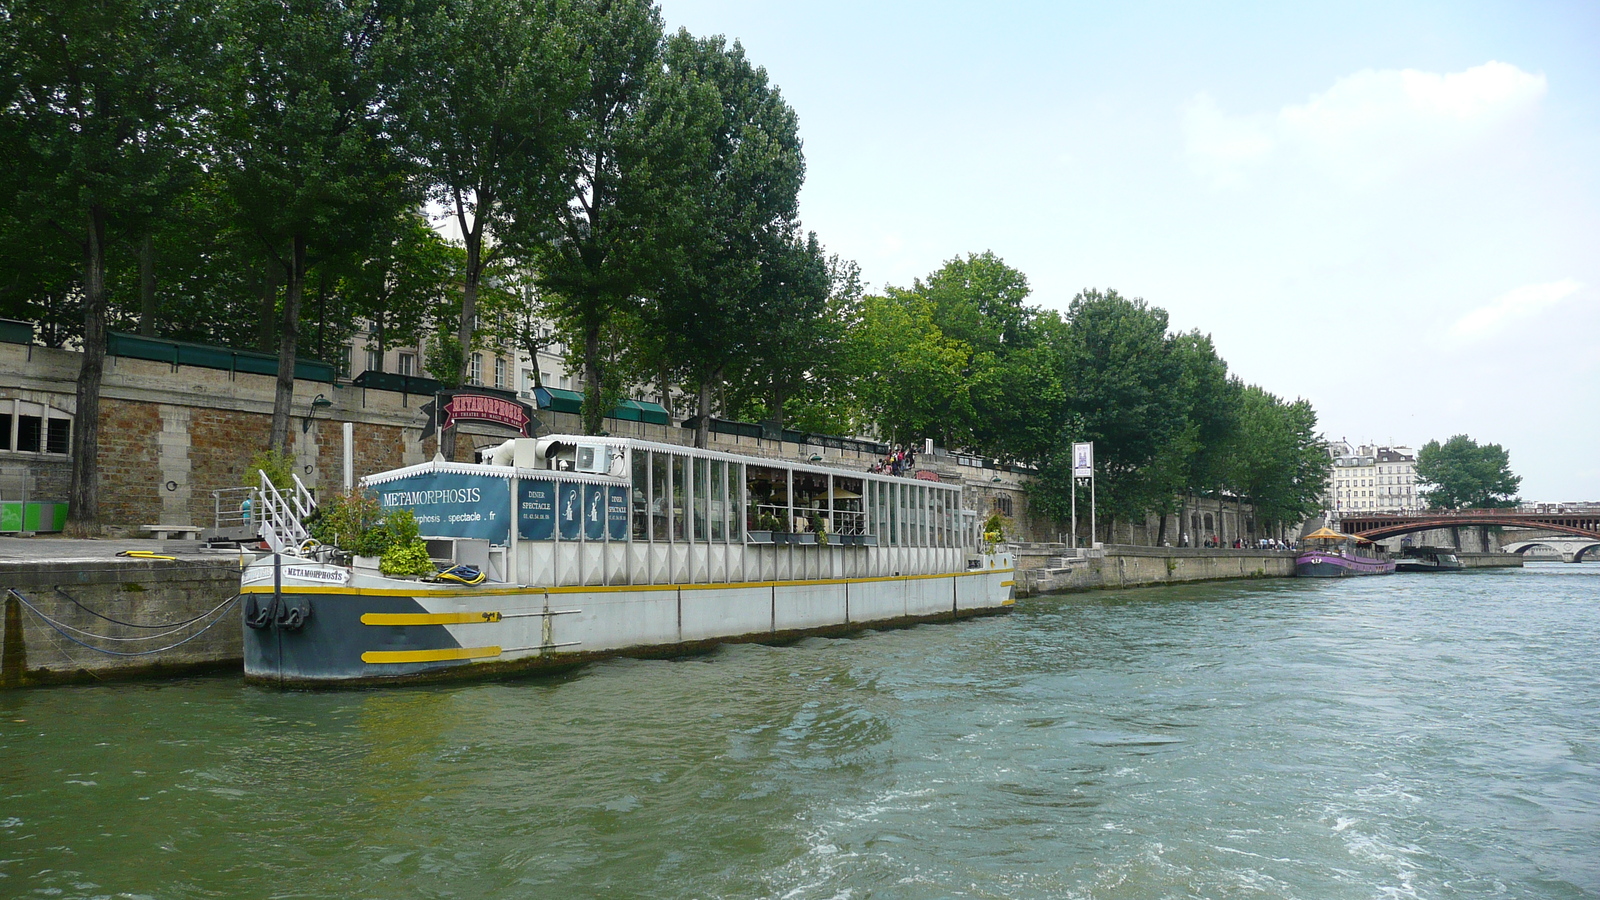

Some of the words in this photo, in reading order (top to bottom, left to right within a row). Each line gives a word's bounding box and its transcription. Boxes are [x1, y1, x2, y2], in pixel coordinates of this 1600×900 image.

[383, 487, 481, 507] METAMORPHOSIS
[522, 502, 551, 510] SPECTACLE
[448, 512, 481, 525] spectacle
[288, 568, 343, 581] METAMORPHOSIS
